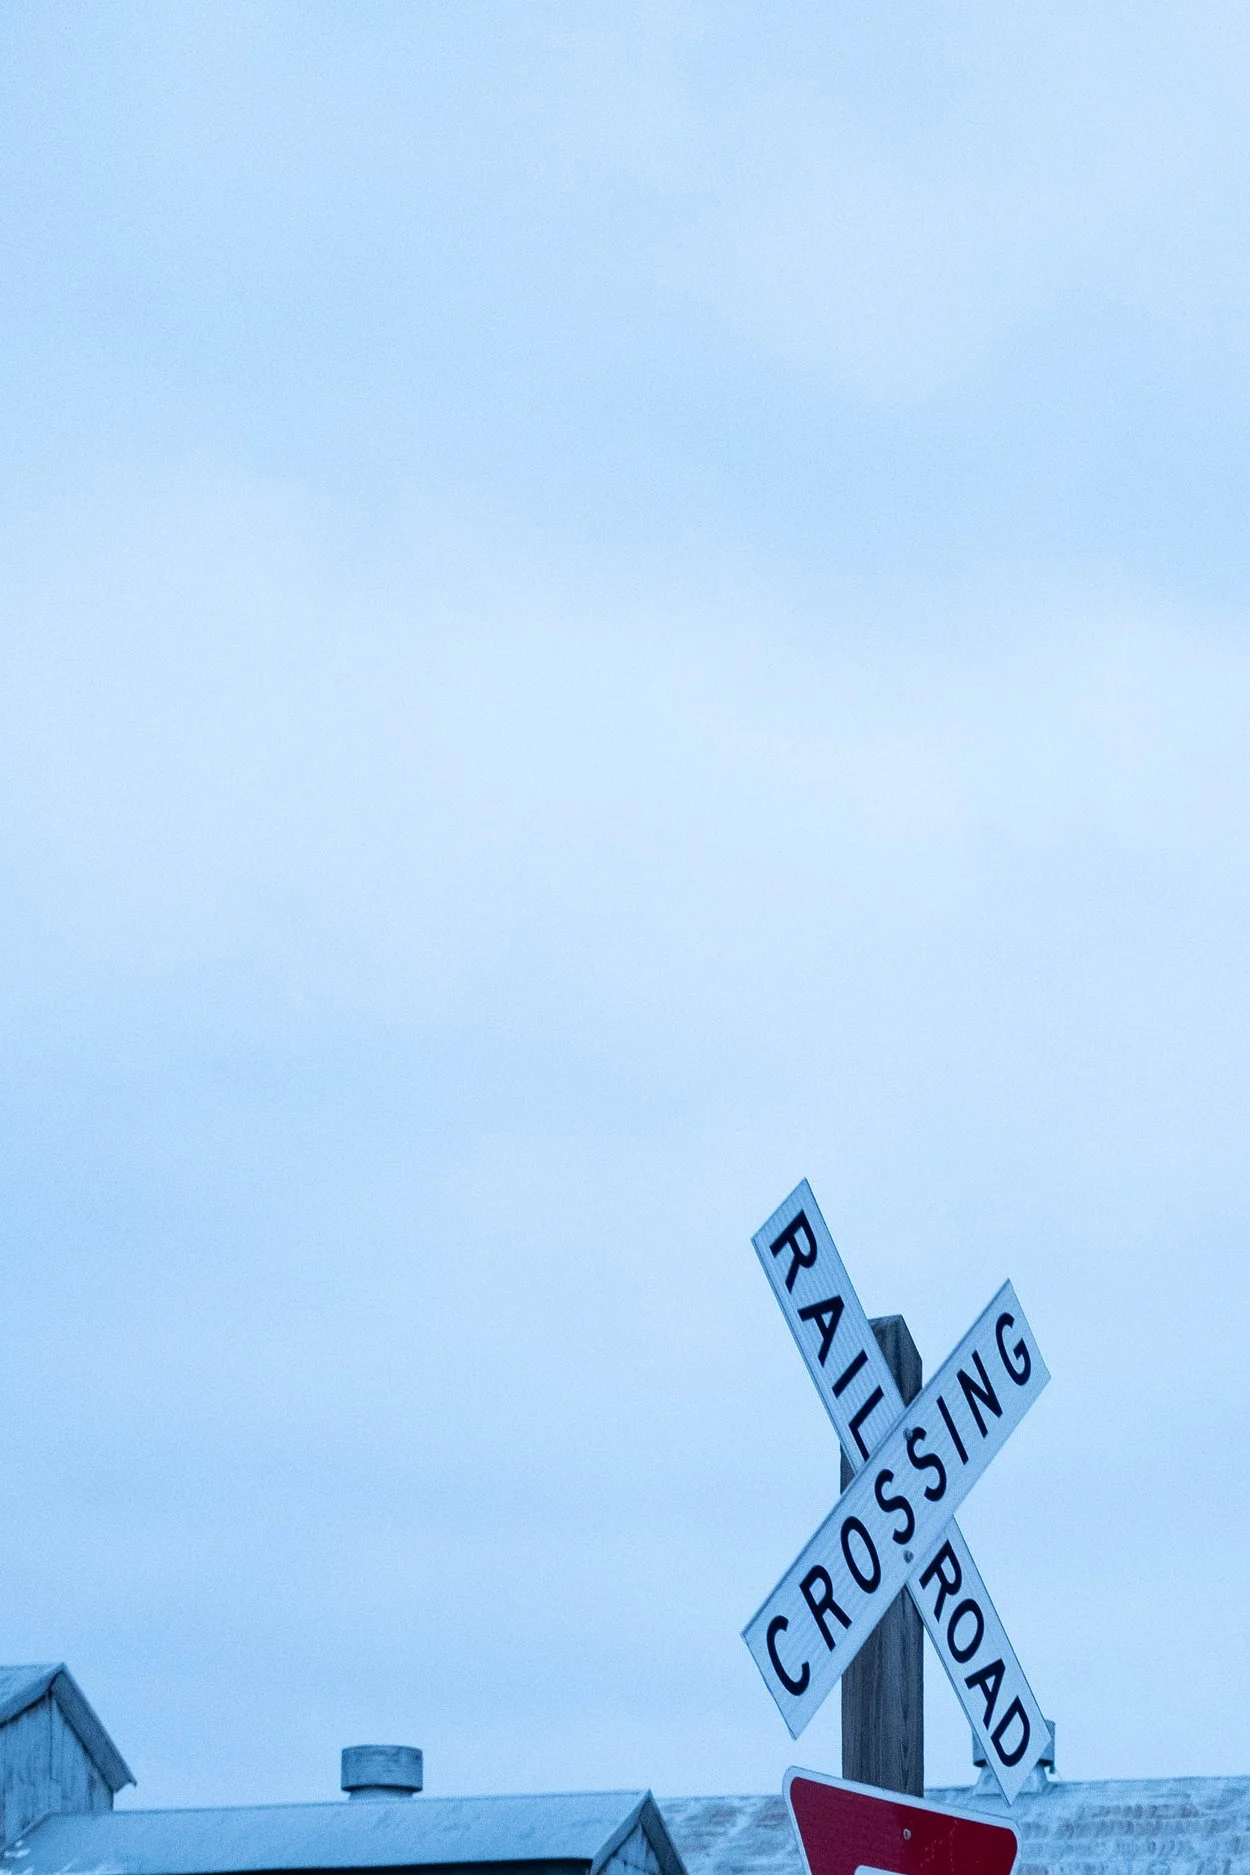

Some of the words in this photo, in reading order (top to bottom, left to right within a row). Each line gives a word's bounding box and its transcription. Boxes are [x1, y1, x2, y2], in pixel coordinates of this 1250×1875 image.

[766, 1312, 1032, 1697] CROSSING
[769, 1208, 884, 1462] RAIL
[919, 1539, 1031, 1767] ROAD
